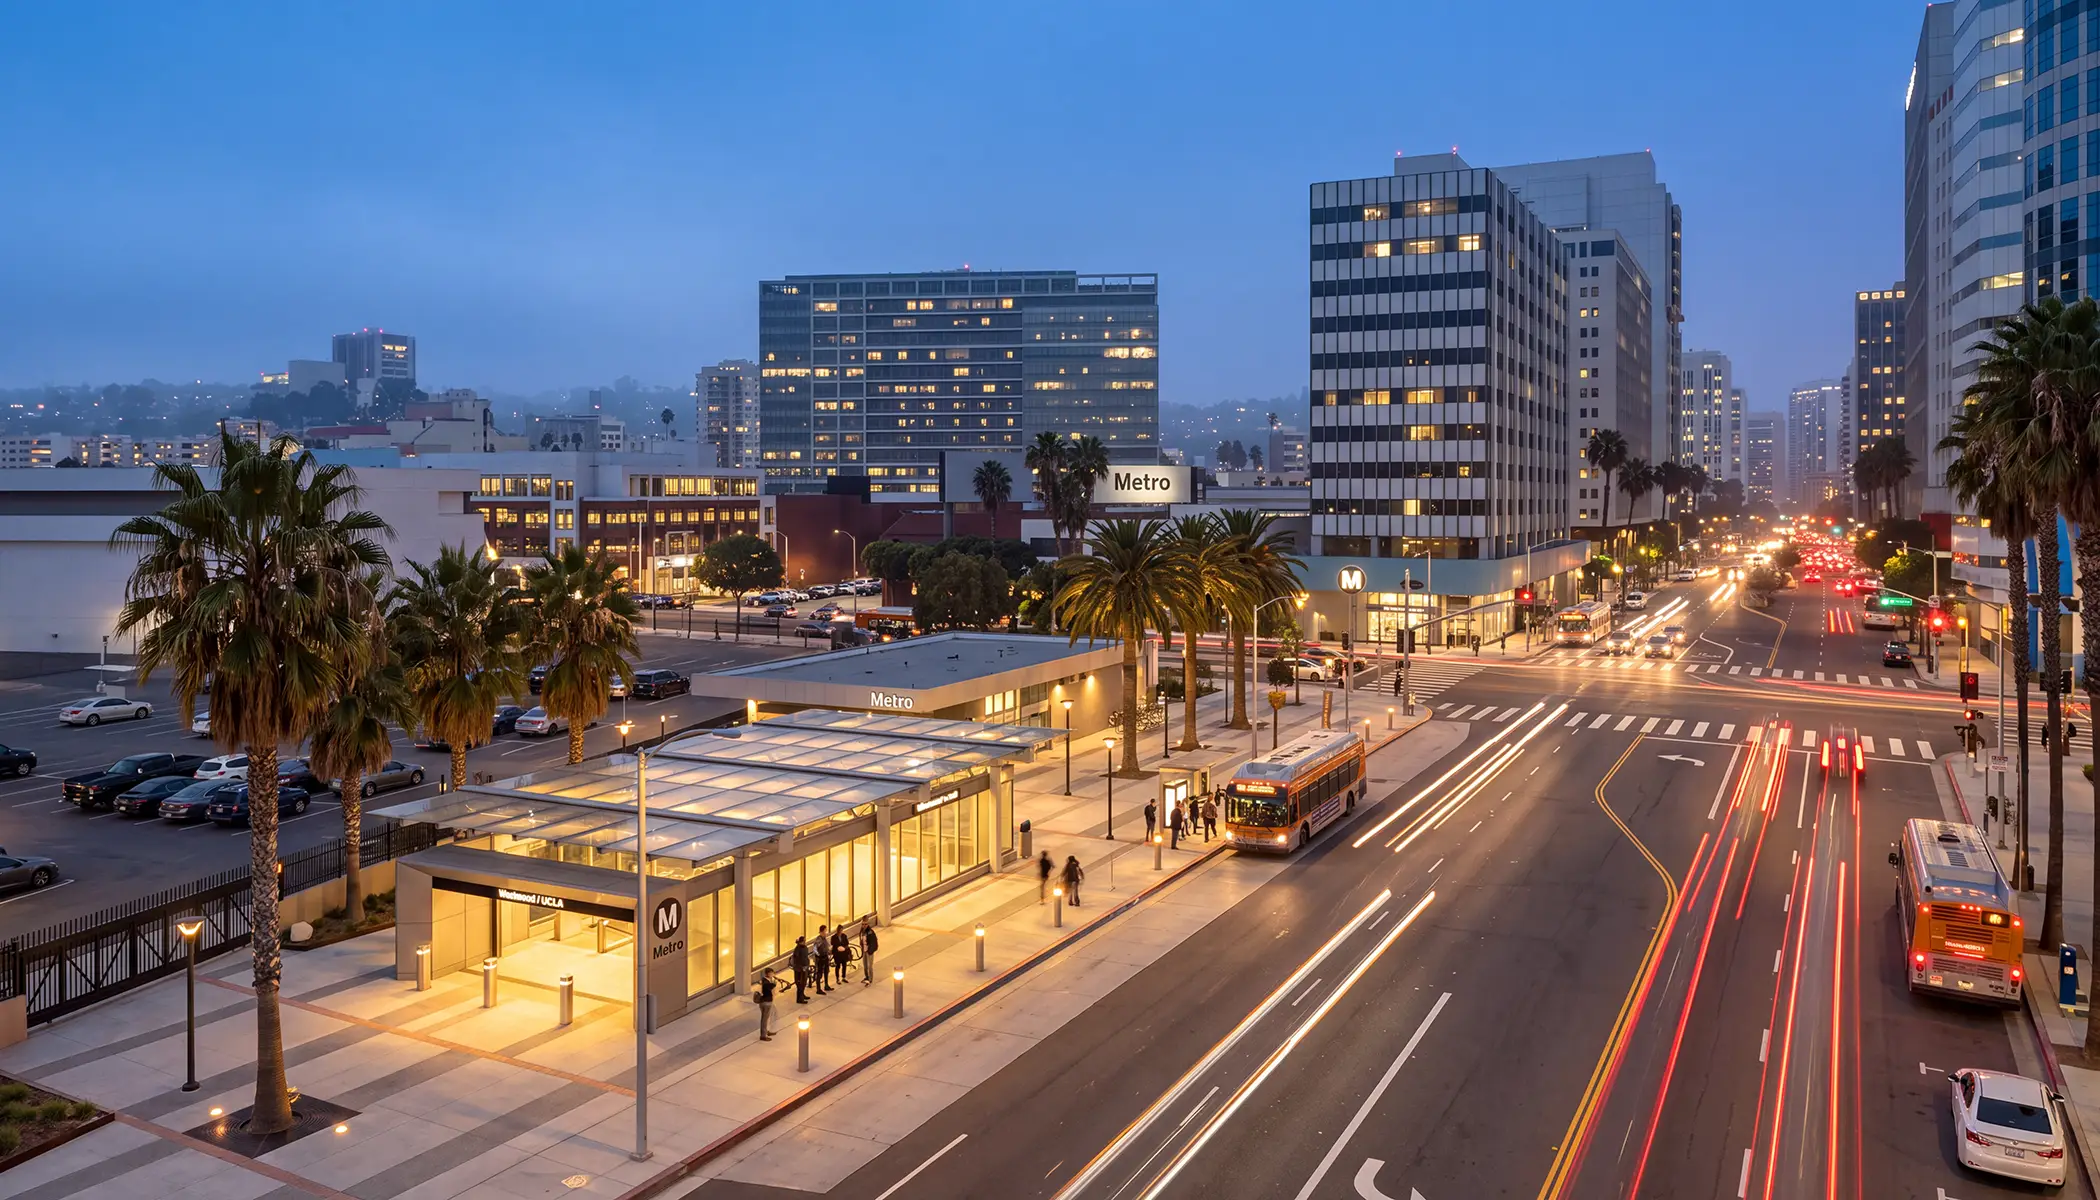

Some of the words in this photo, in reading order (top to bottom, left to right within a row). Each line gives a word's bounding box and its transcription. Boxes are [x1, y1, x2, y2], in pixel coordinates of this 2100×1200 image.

[1114, 472, 1171, 491] Metro
[1341, 569, 1362, 590] M
[870, 691, 914, 709] Metro
[541, 895, 564, 908] UCLA
[657, 902, 678, 934] M
[652, 940, 684, 960] Metro
